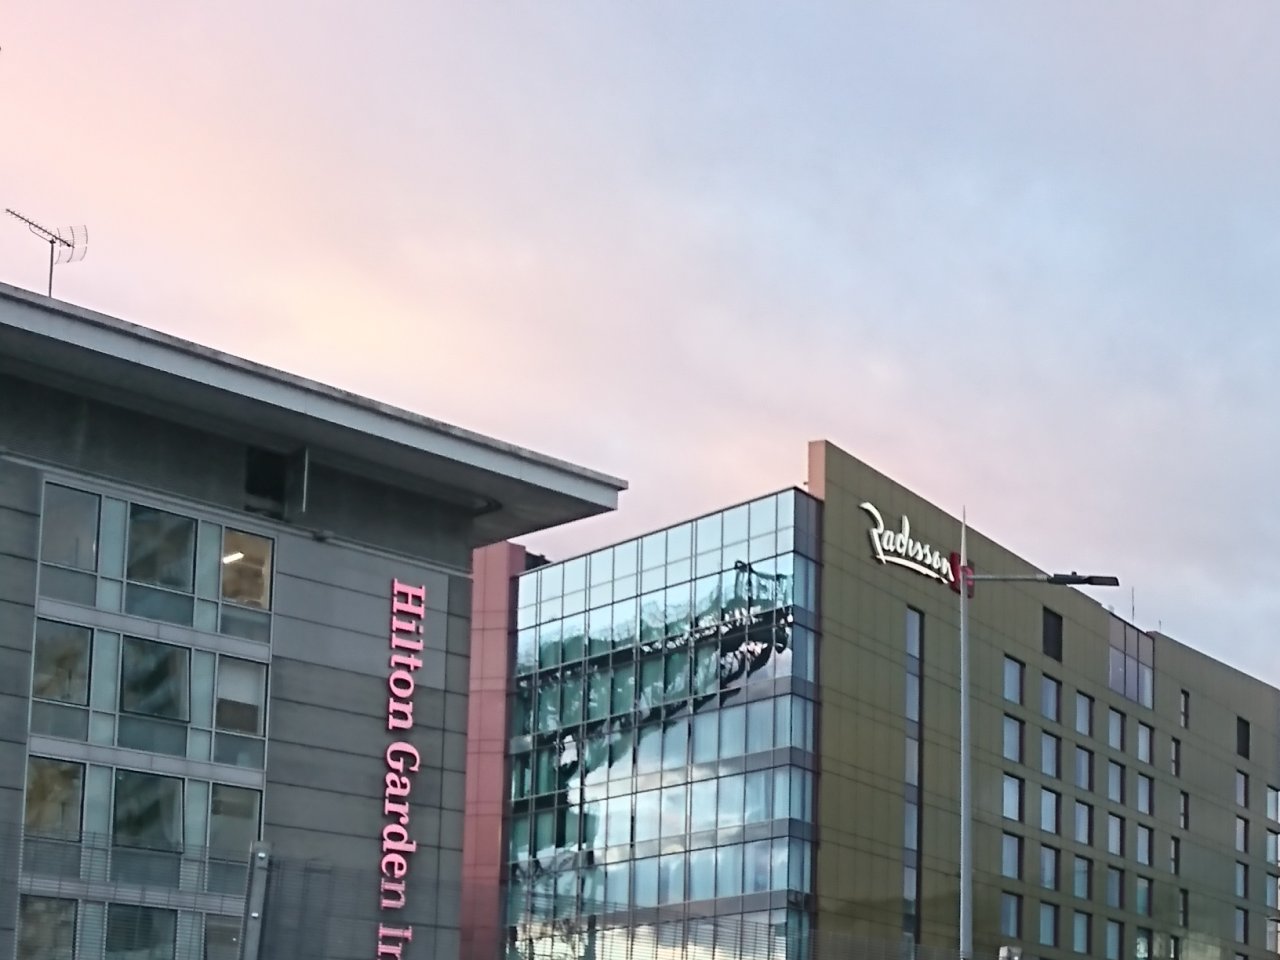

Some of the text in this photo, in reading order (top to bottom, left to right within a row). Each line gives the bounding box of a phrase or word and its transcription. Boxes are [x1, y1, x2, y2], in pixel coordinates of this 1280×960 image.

[860, 501, 954, 584] Radisson
[388, 578, 427, 731] Hilton
[380, 741, 421, 911] Garden
